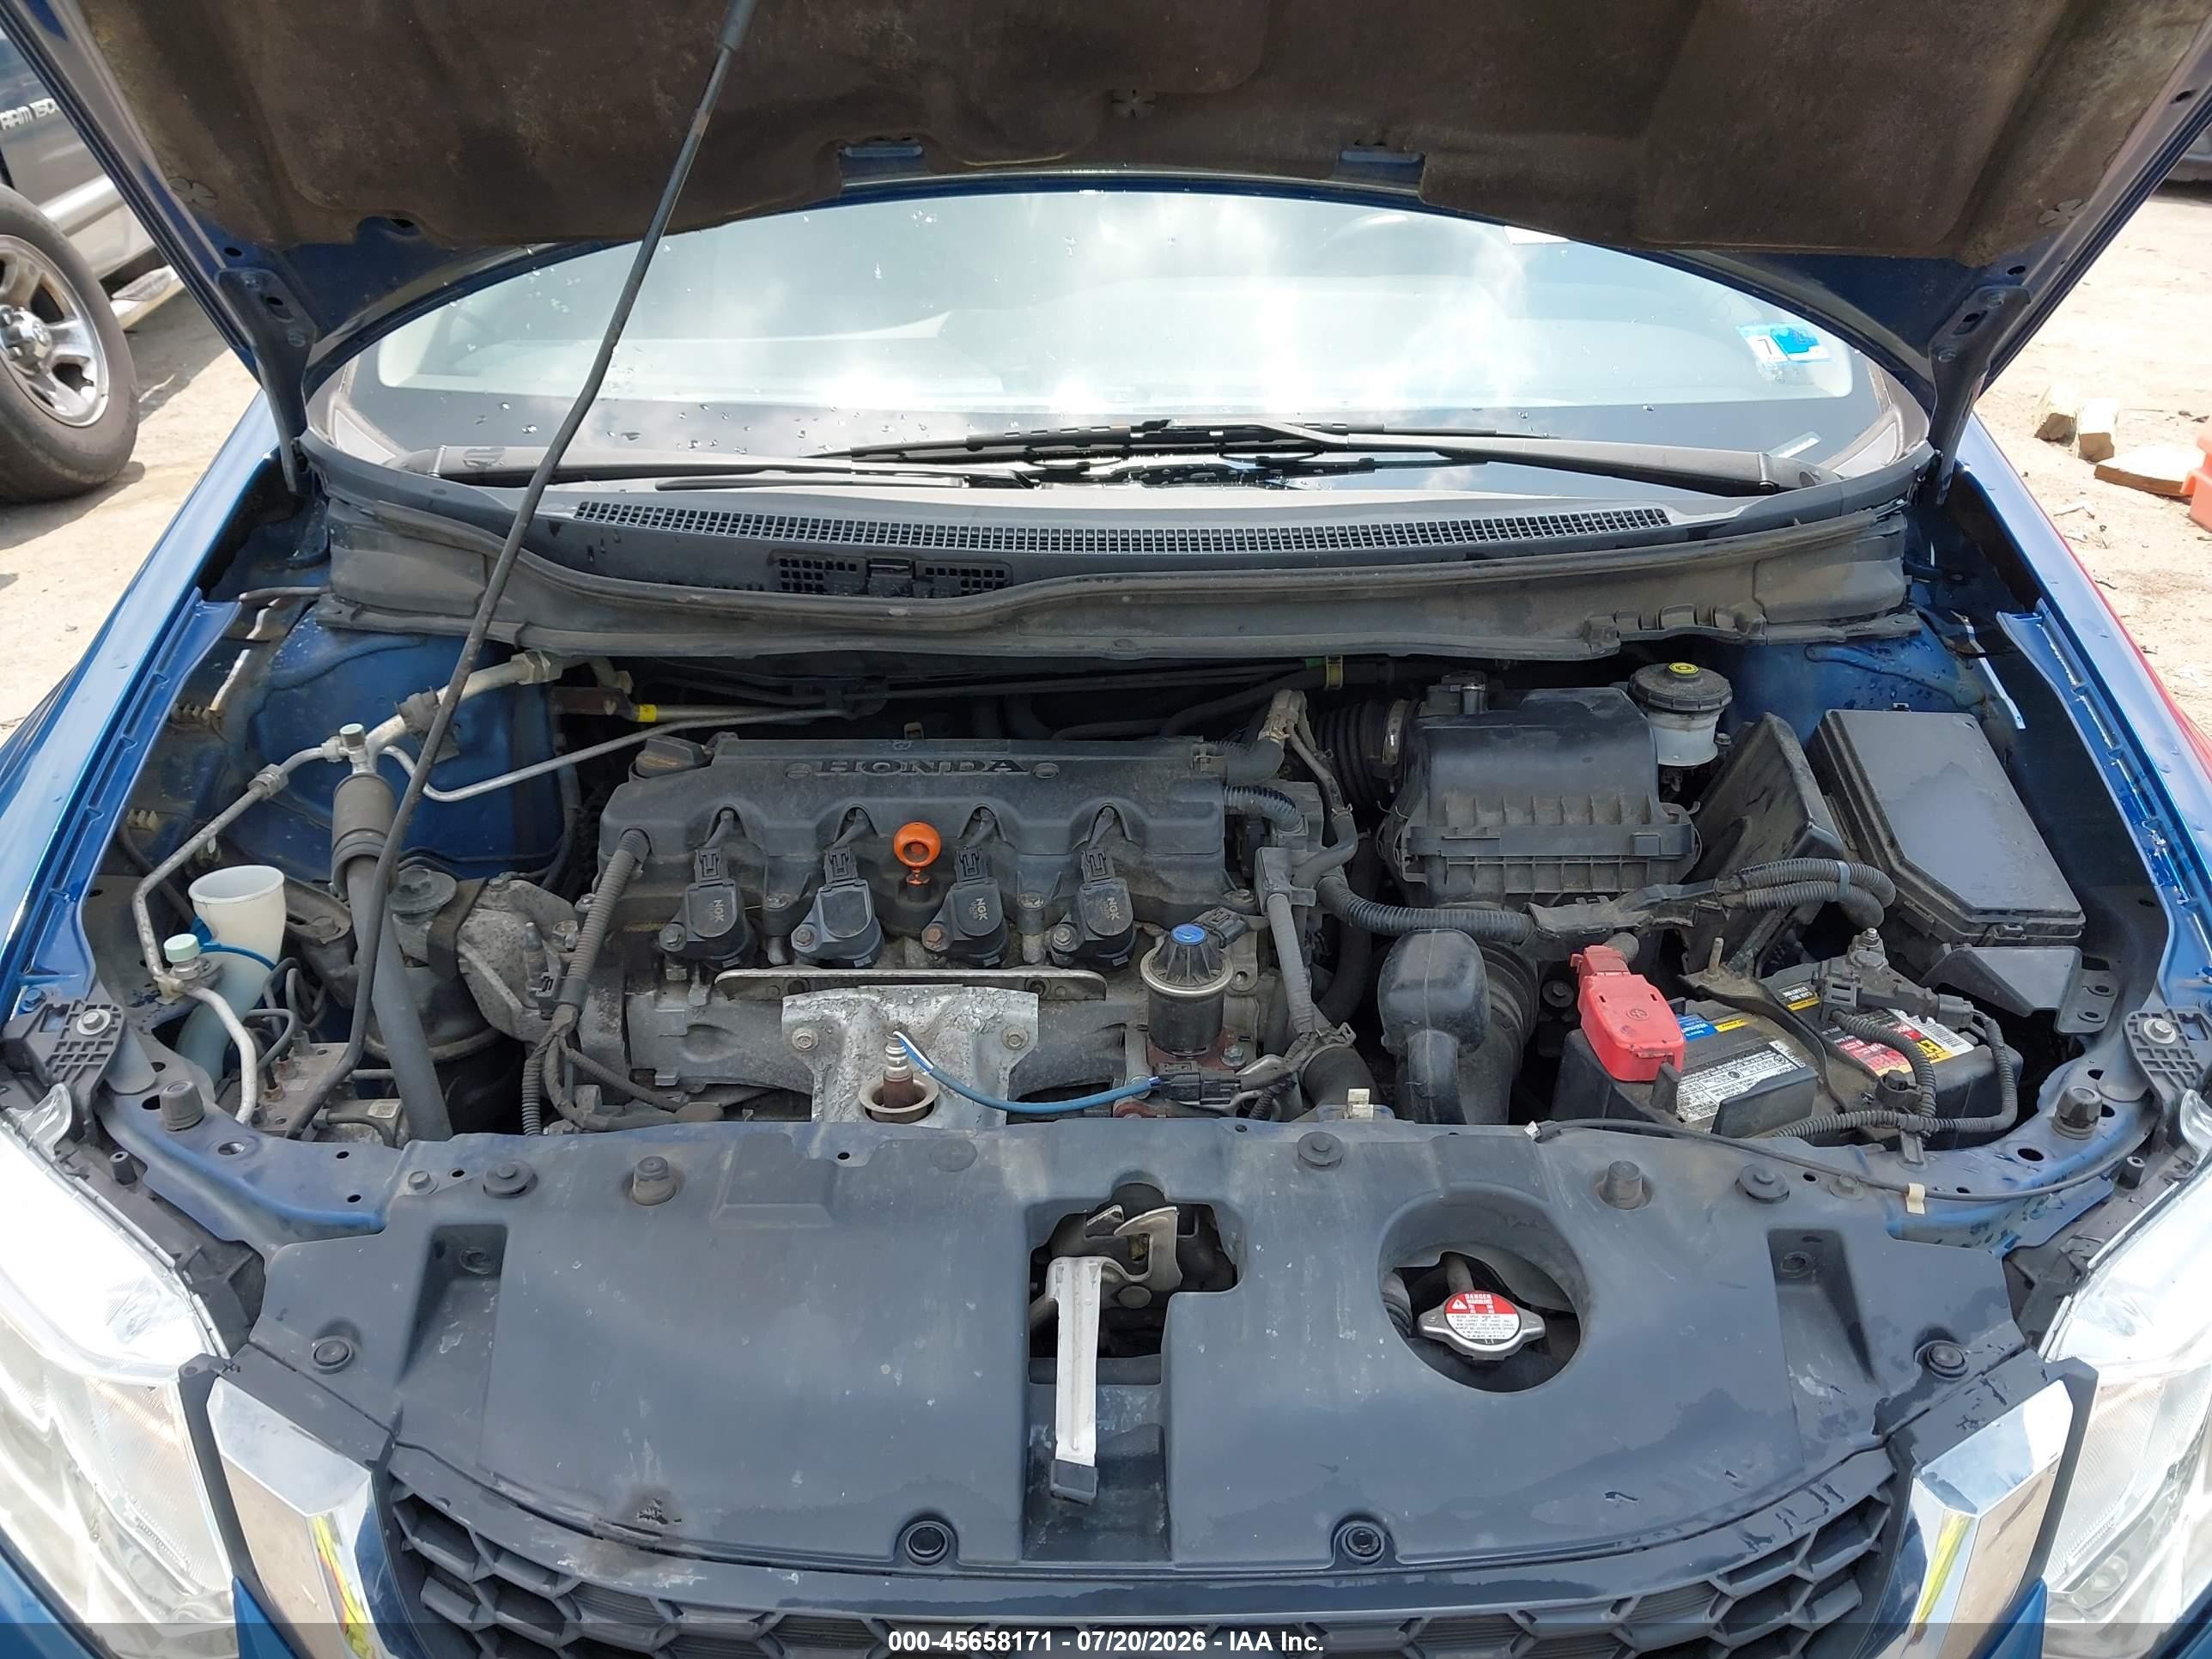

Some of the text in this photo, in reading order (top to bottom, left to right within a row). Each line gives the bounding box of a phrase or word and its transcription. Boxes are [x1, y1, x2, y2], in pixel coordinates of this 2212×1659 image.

[0, 98, 60, 131] RAM 150
[817, 759, 1030, 775] HONDA
[975, 897, 988, 921] NGK
[1107, 897, 1120, 921] NGK
